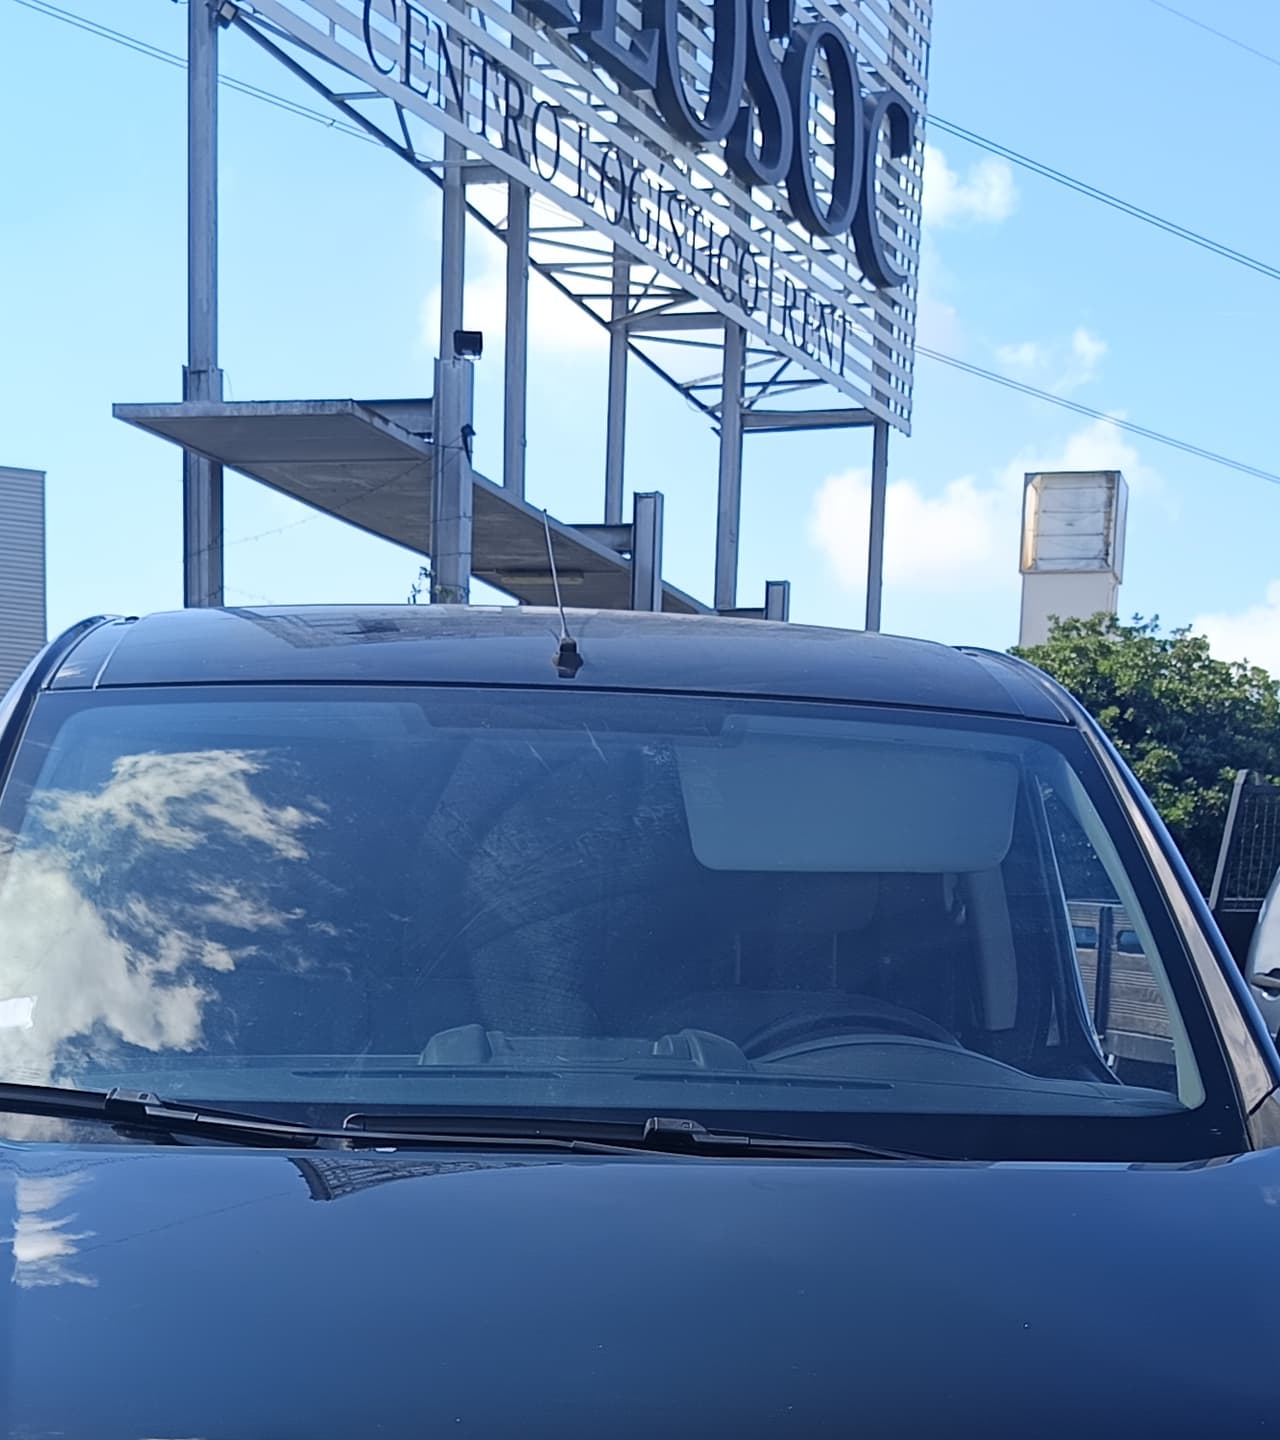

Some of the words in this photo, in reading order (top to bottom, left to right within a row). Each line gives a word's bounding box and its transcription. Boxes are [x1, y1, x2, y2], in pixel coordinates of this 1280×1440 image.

[362, 0, 560, 182] CENTRO
[577, 123, 759, 317] LOGÍSTICO
[781, 276, 852, 377] RENT
